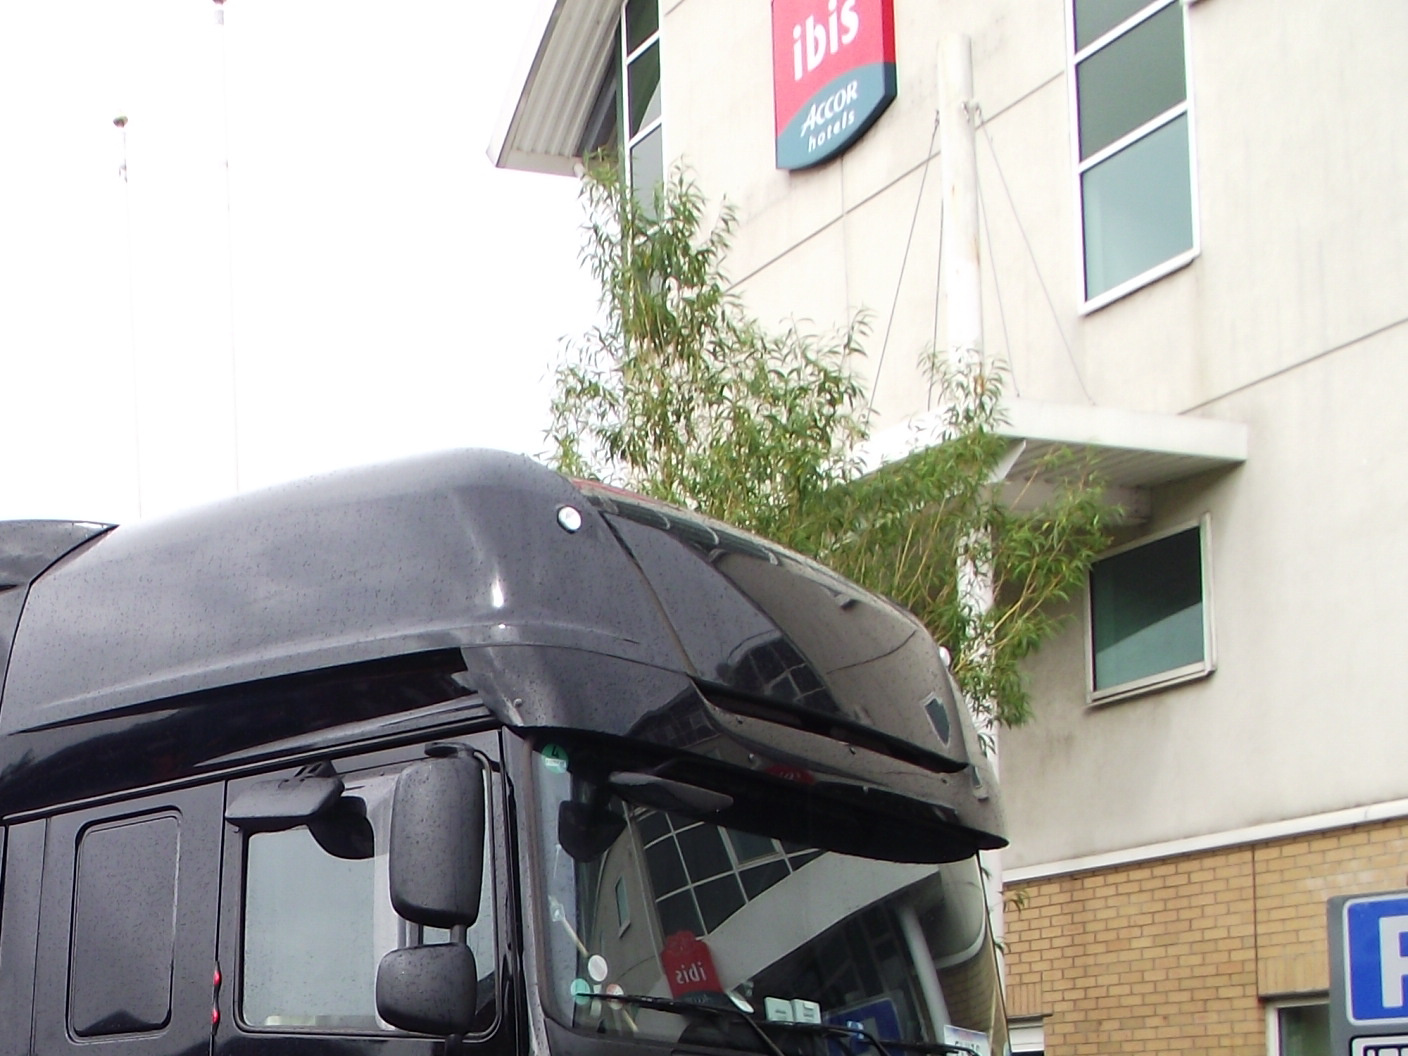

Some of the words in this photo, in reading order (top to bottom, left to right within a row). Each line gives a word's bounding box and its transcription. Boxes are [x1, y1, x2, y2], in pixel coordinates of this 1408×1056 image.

[792, 0, 859, 81] ibis
[800, 80, 858, 137] ACCOR
[808, 109, 855, 152] hotels
